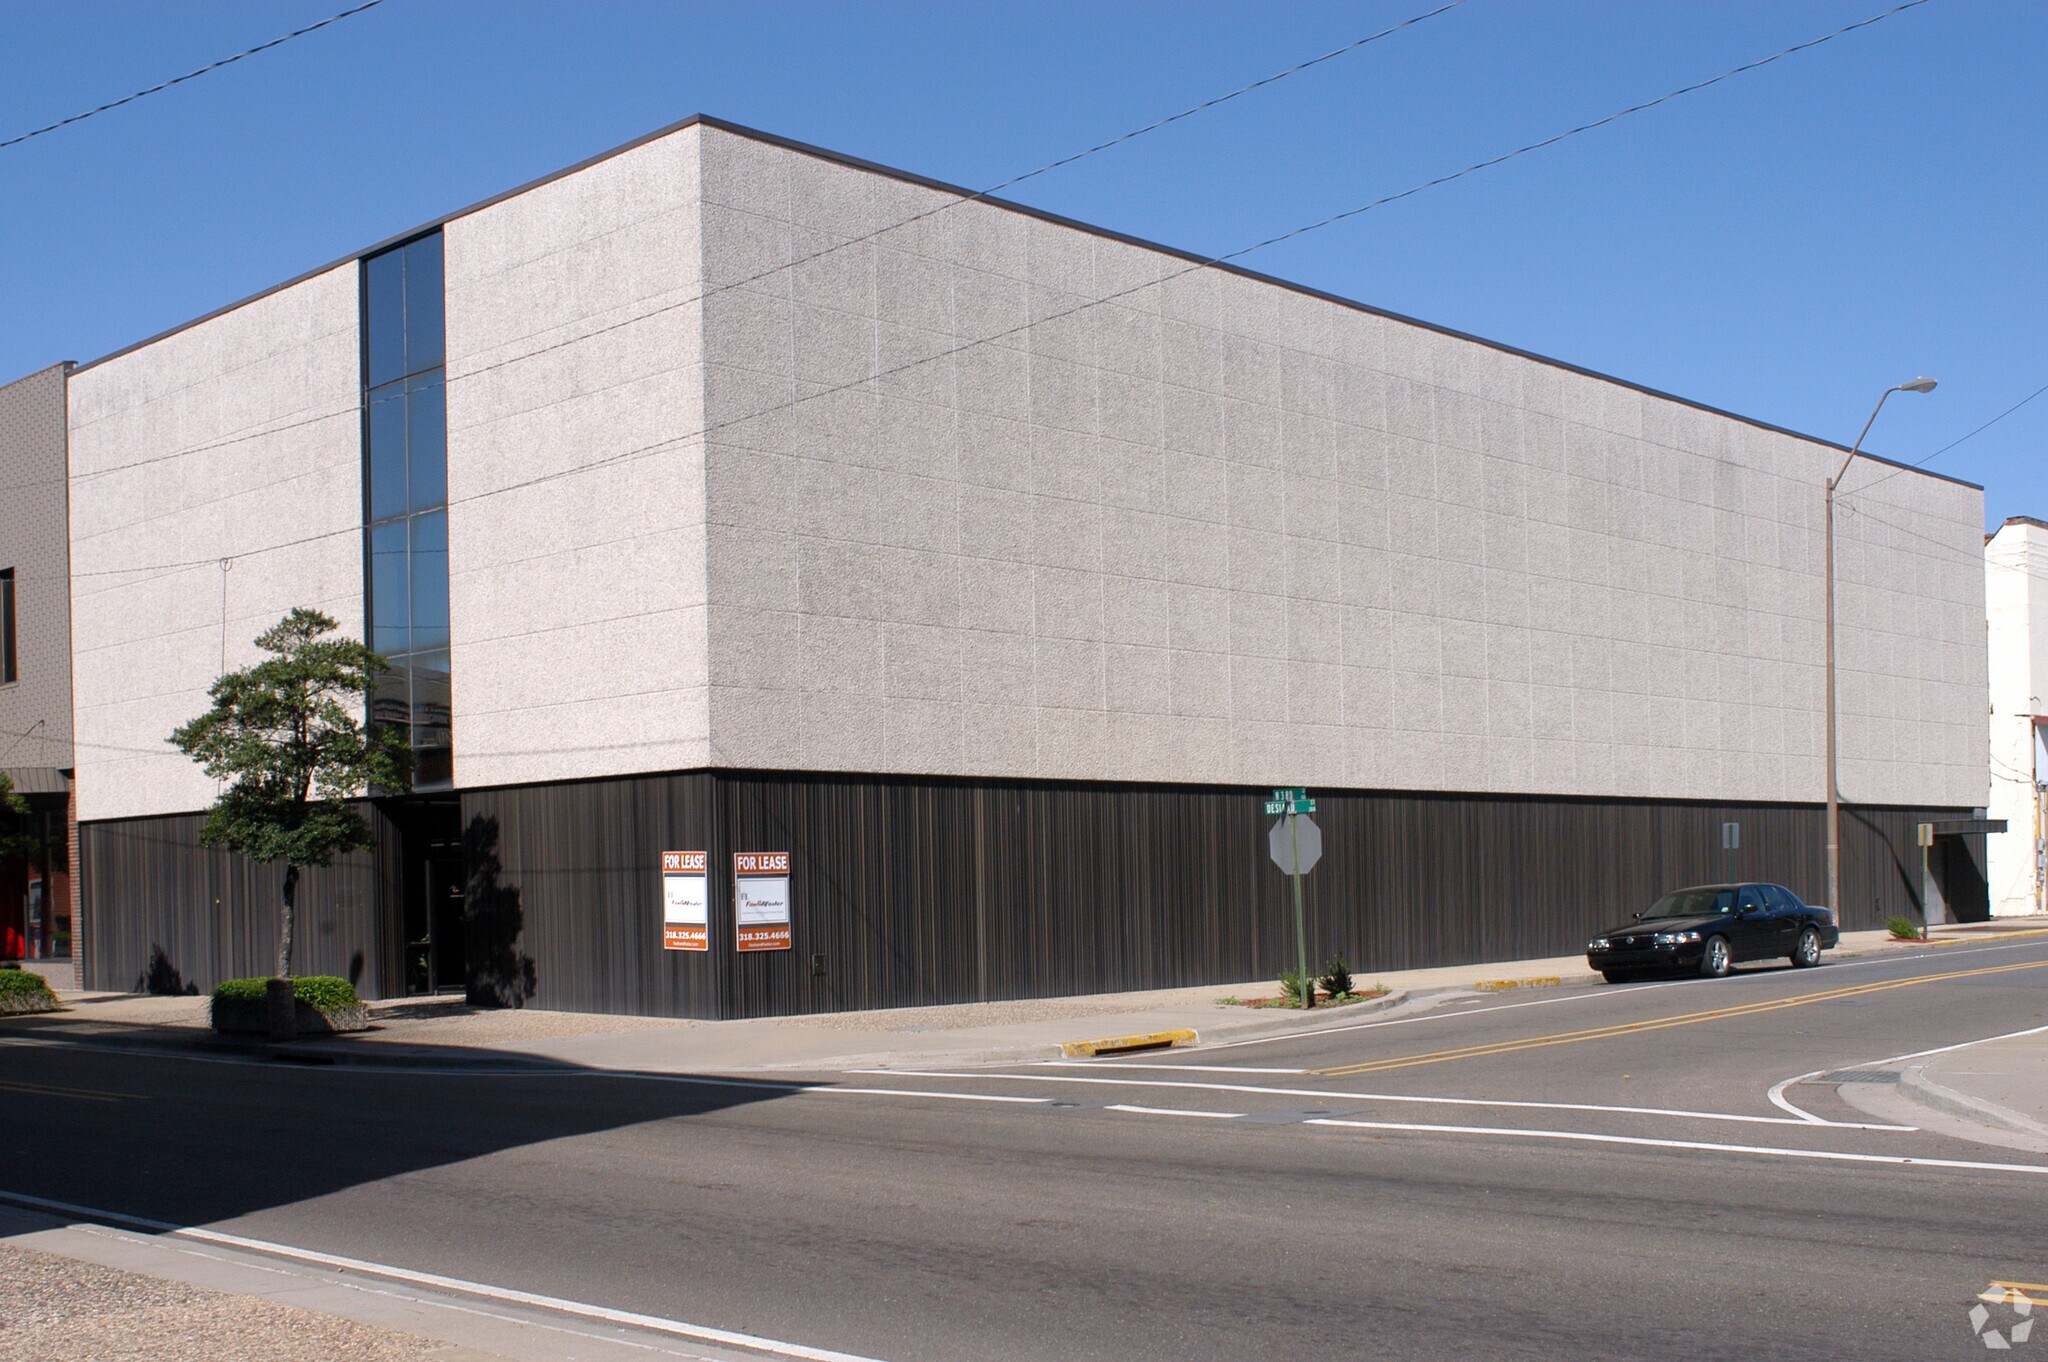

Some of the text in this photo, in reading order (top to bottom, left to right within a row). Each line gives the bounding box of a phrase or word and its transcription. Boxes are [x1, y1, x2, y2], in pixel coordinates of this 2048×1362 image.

[664, 854, 704, 869] FOR LEASE
[737, 855, 787, 870] FOR LEASE
[739, 931, 789, 941] 318.325.4666
